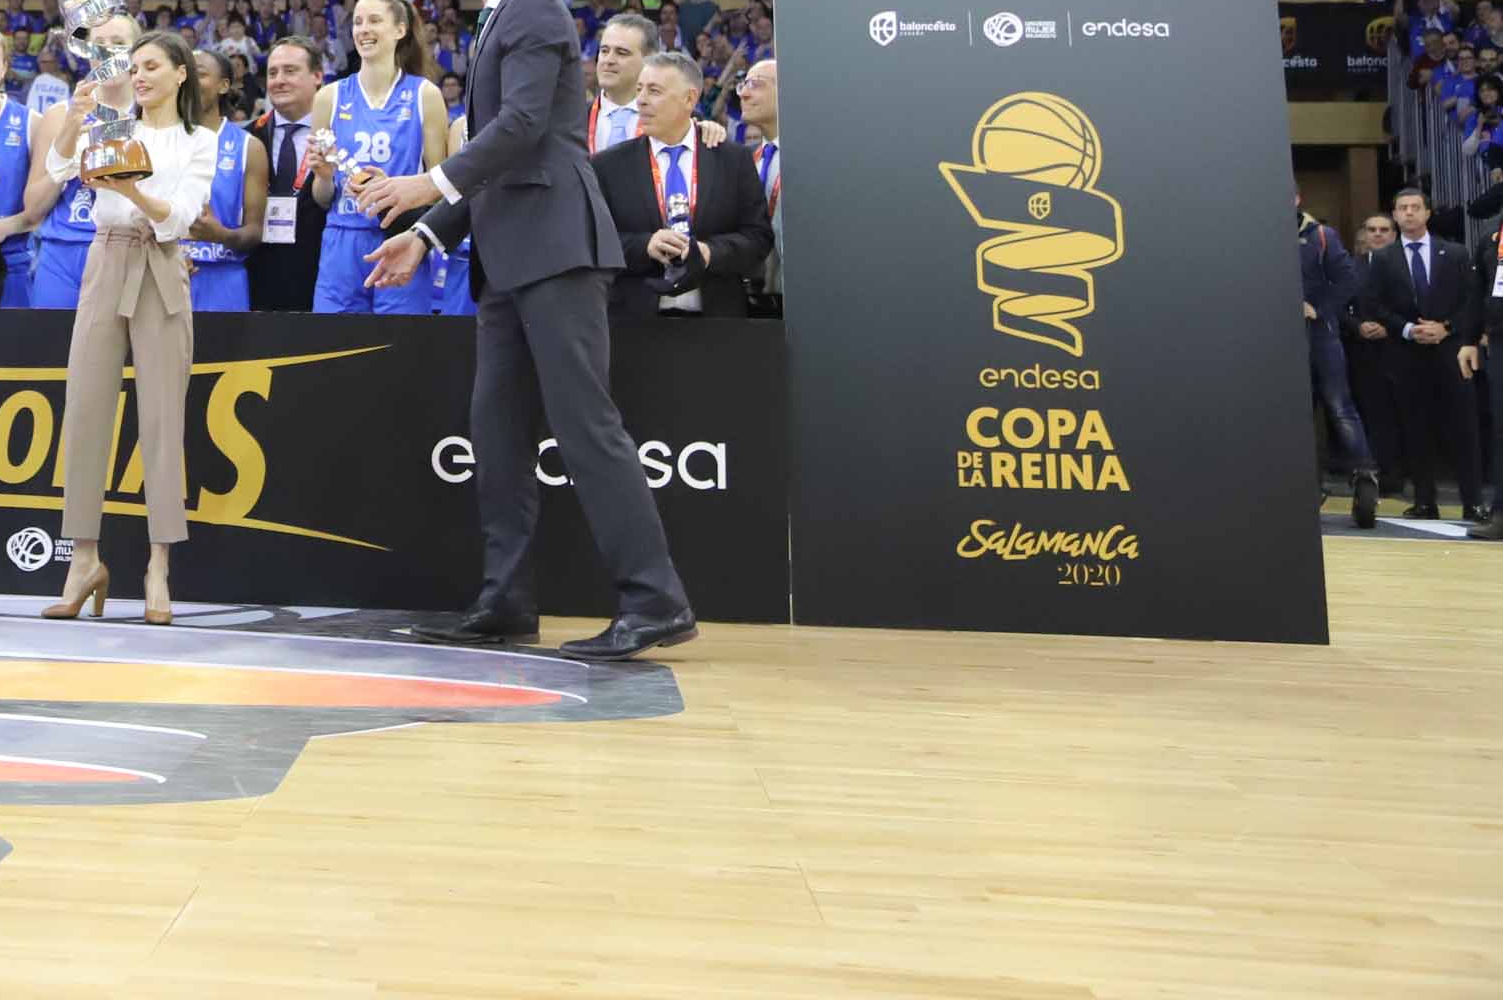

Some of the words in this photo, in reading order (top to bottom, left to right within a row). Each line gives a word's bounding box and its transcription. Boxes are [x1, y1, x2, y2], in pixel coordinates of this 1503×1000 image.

[1082, 18, 1170, 37] endesa
[354, 131, 392, 162] 28
[979, 363, 1101, 390] endesa
[965, 406, 1115, 451] COPA
[957, 451, 984, 469] DE
[991, 452, 1131, 492] REINA
[958, 469, 987, 488] LA
[1056, 563, 1122, 586] 2020
